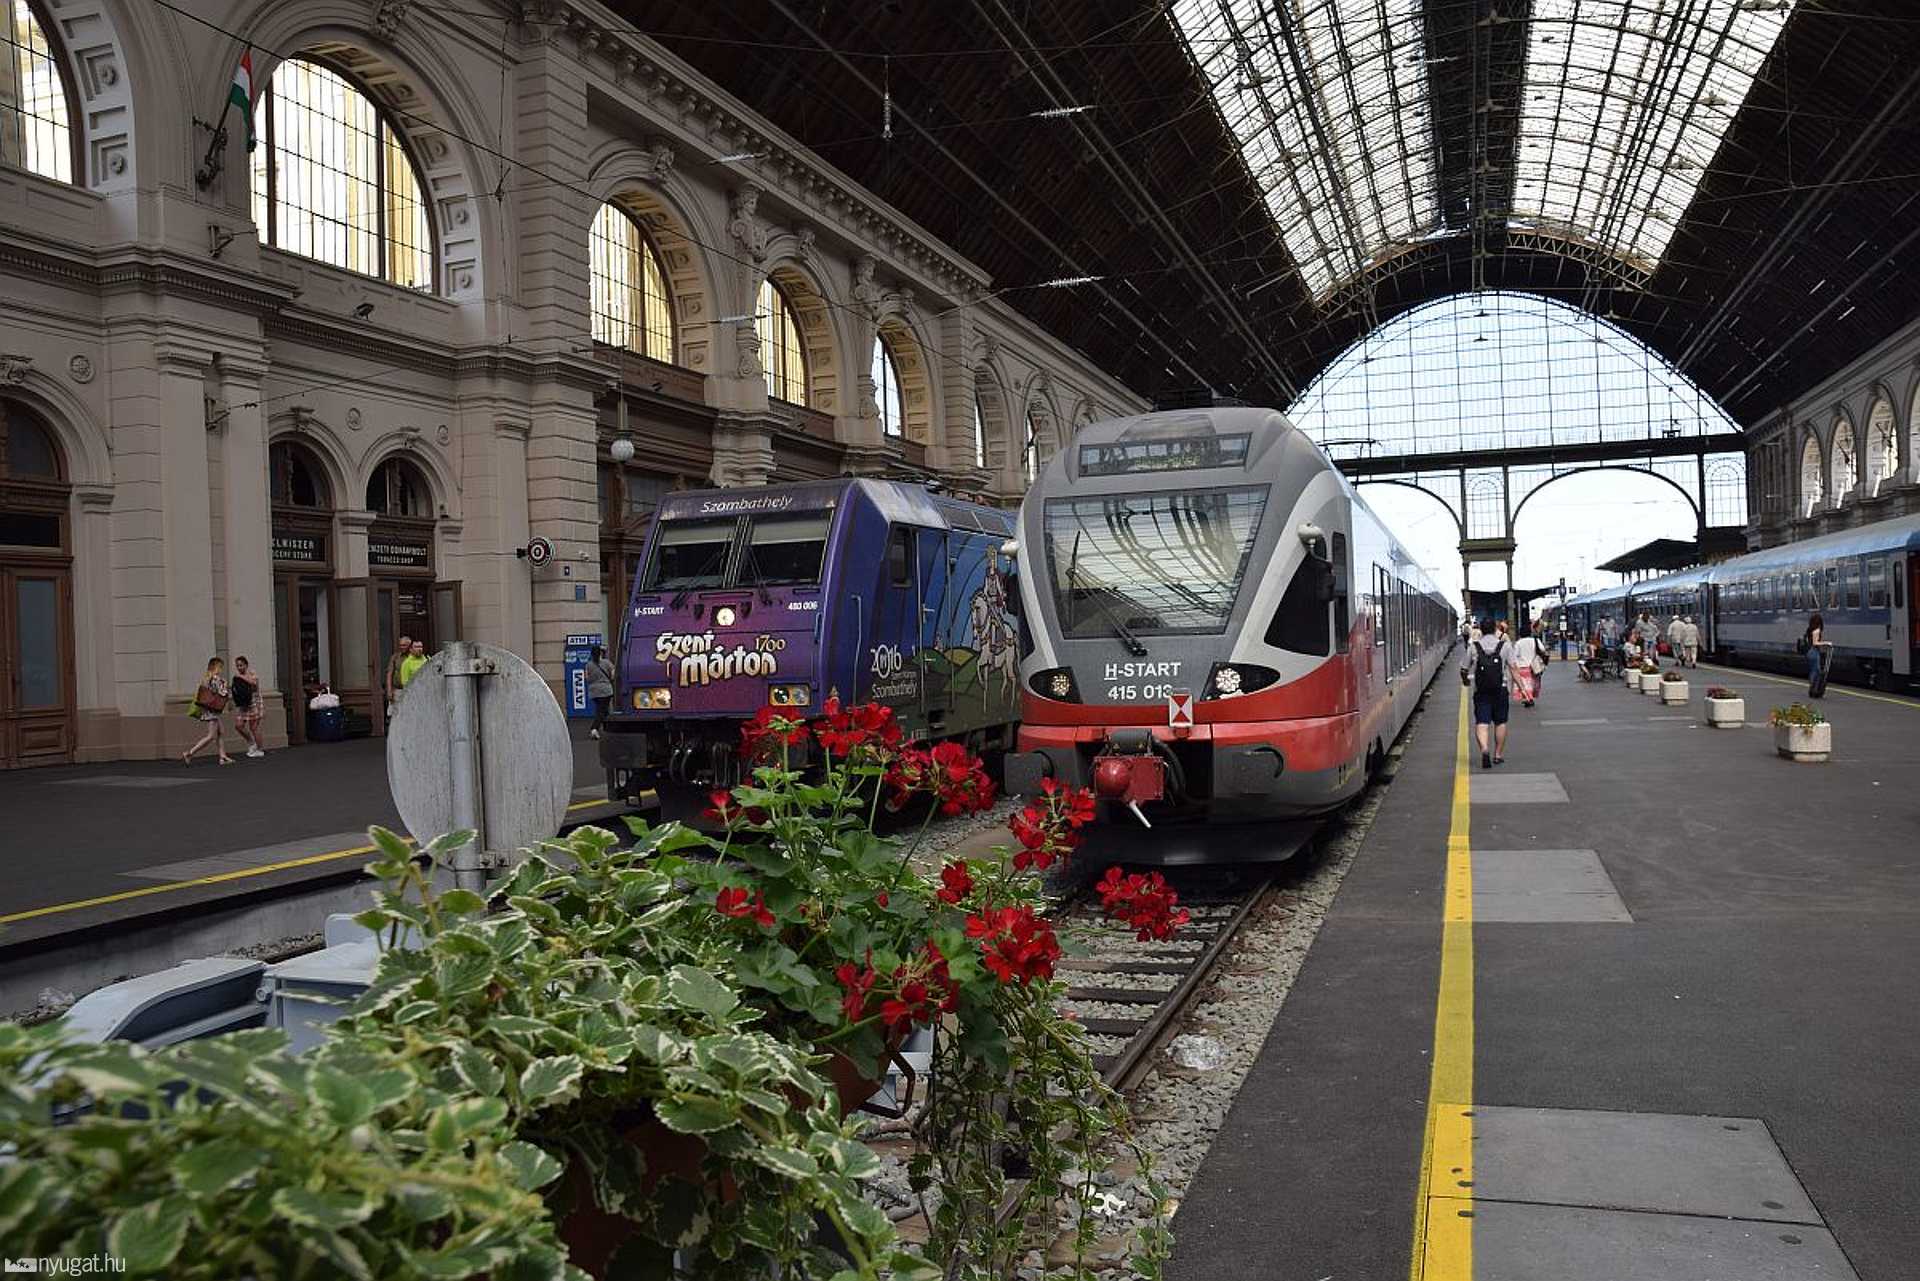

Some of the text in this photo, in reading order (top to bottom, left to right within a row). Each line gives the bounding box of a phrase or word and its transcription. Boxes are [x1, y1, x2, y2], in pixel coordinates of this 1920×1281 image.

[700, 494, 793, 513] Szombathely
[569, 637, 586, 645] ATM
[656, 631, 715, 662] Szent
[755, 635, 786, 652] 1700
[1104, 662, 1182, 681] H-START
[575, 672, 583, 706] ATM
[1107, 684, 1137, 700] 415
